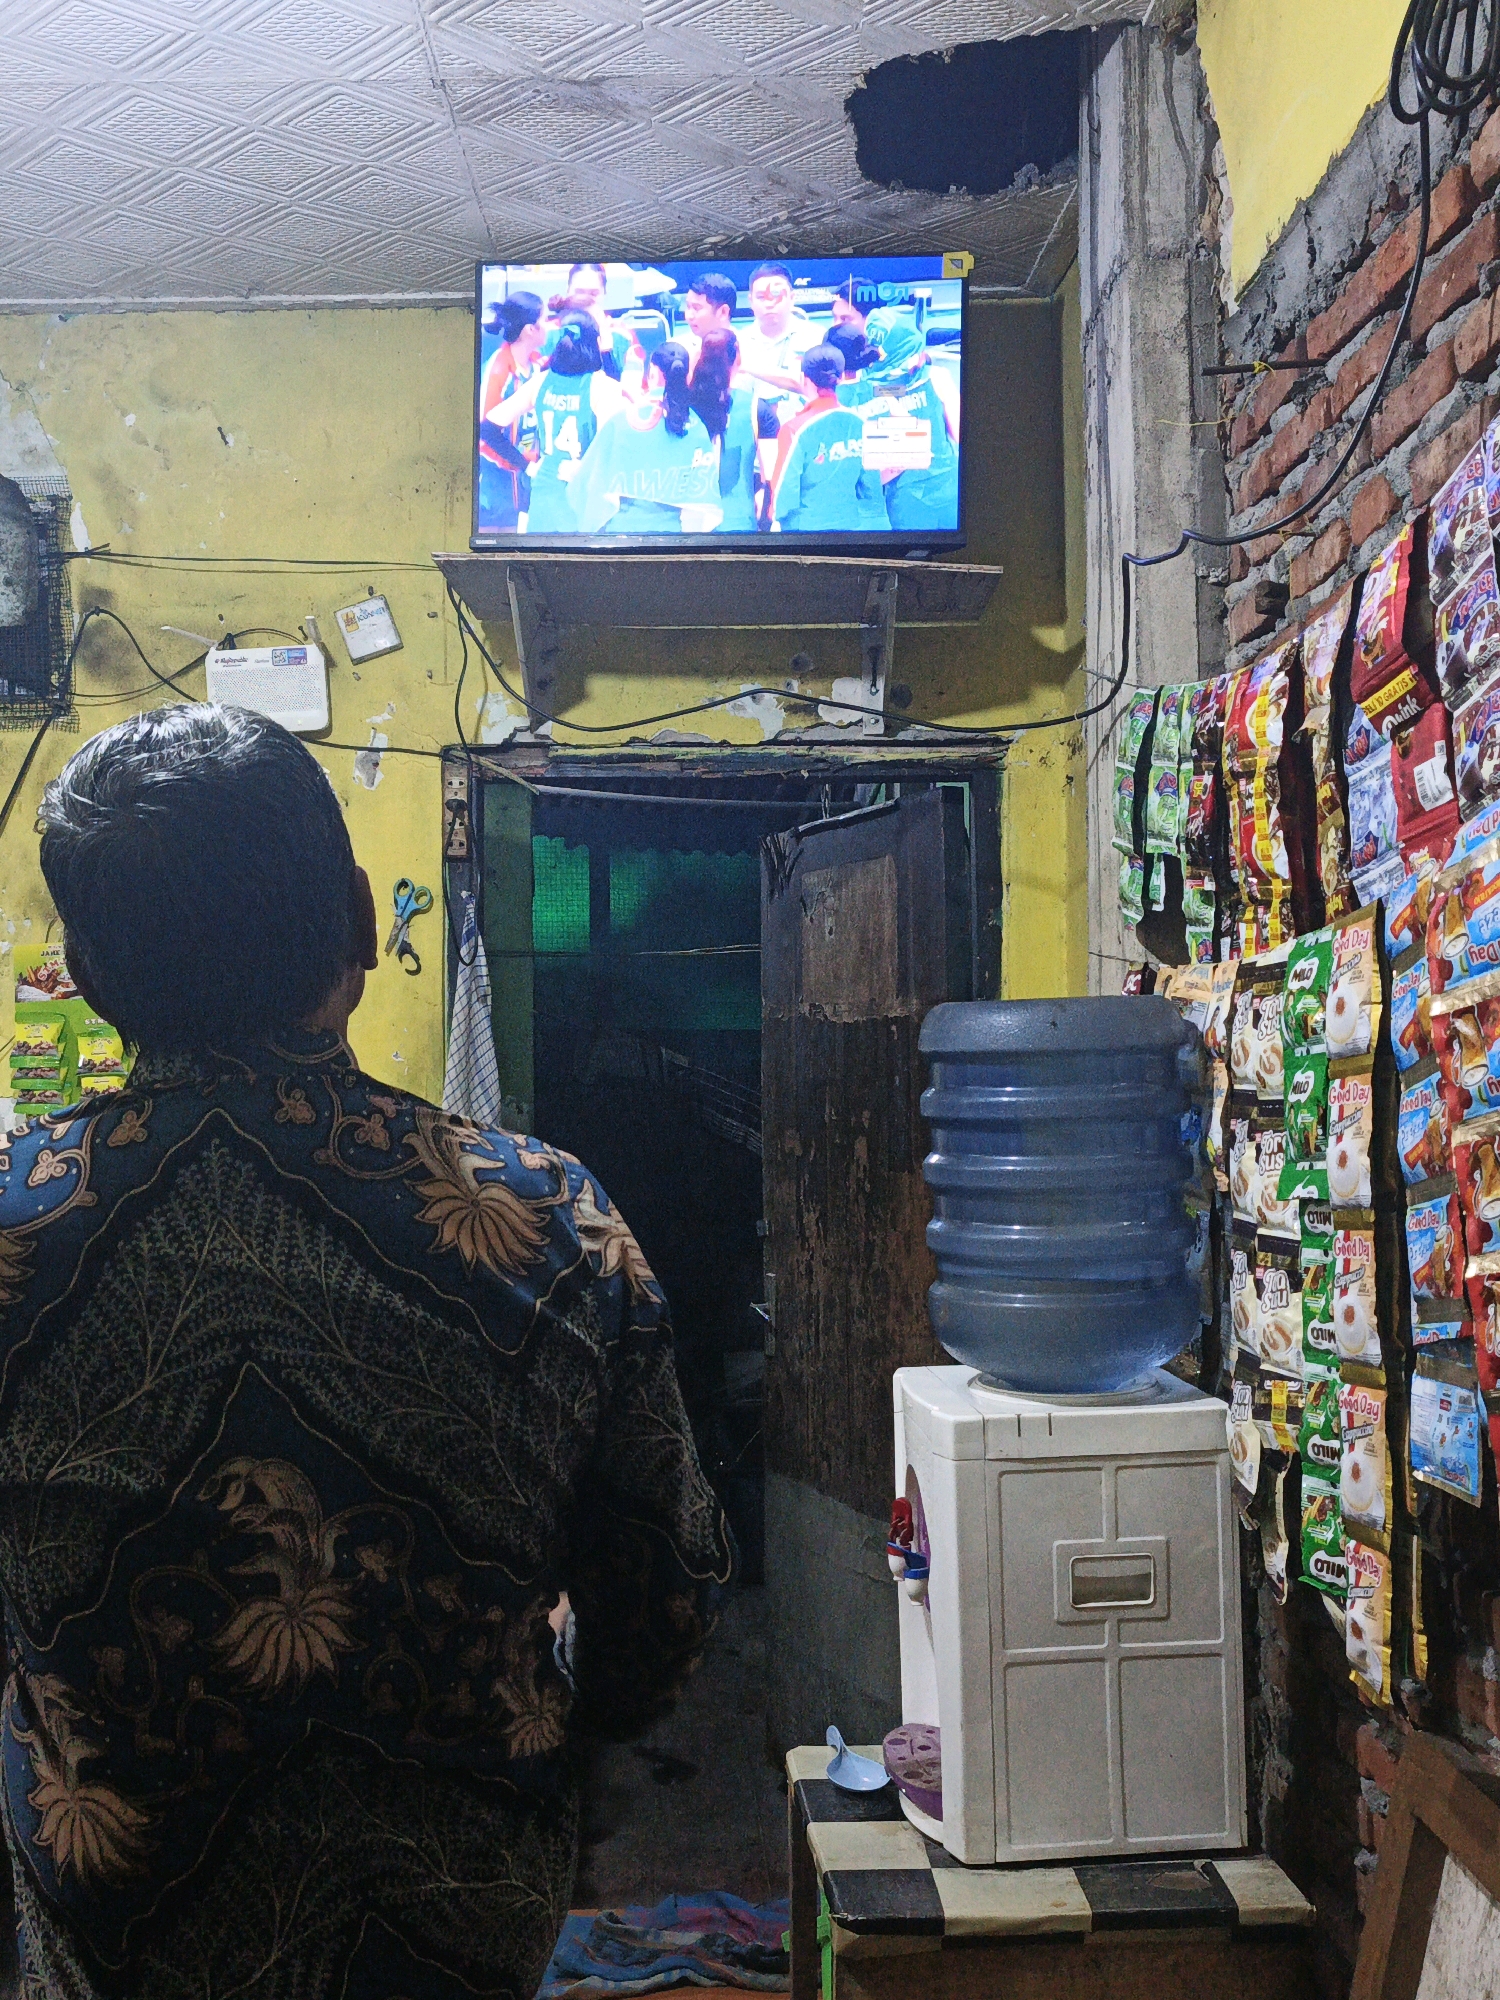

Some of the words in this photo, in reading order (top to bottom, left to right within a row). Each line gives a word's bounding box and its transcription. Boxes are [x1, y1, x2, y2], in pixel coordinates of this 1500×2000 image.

[542, 410, 582, 460] 14
[1384, 677, 1410, 702] GRATIS
[1351, 929, 1370, 950] Day
[1469, 938, 1499, 964] Day
[1291, 967, 1314, 983] MILO
[1291, 1080, 1310, 1095] MILO
[1352, 1081, 1370, 1105] Day
[1307, 1210, 1332, 1226] MILO
[1333, 1236, 1357, 1258] Good
[1358, 1237, 1371, 1263] Day
[1310, 1326, 1337, 1344] MILO
[1338, 1391, 1360, 1413] Good
[1360, 1394, 1380, 1422] Day
[1311, 1442, 1341, 1461] MILO
[1313, 1557, 1346, 1581] MILO
